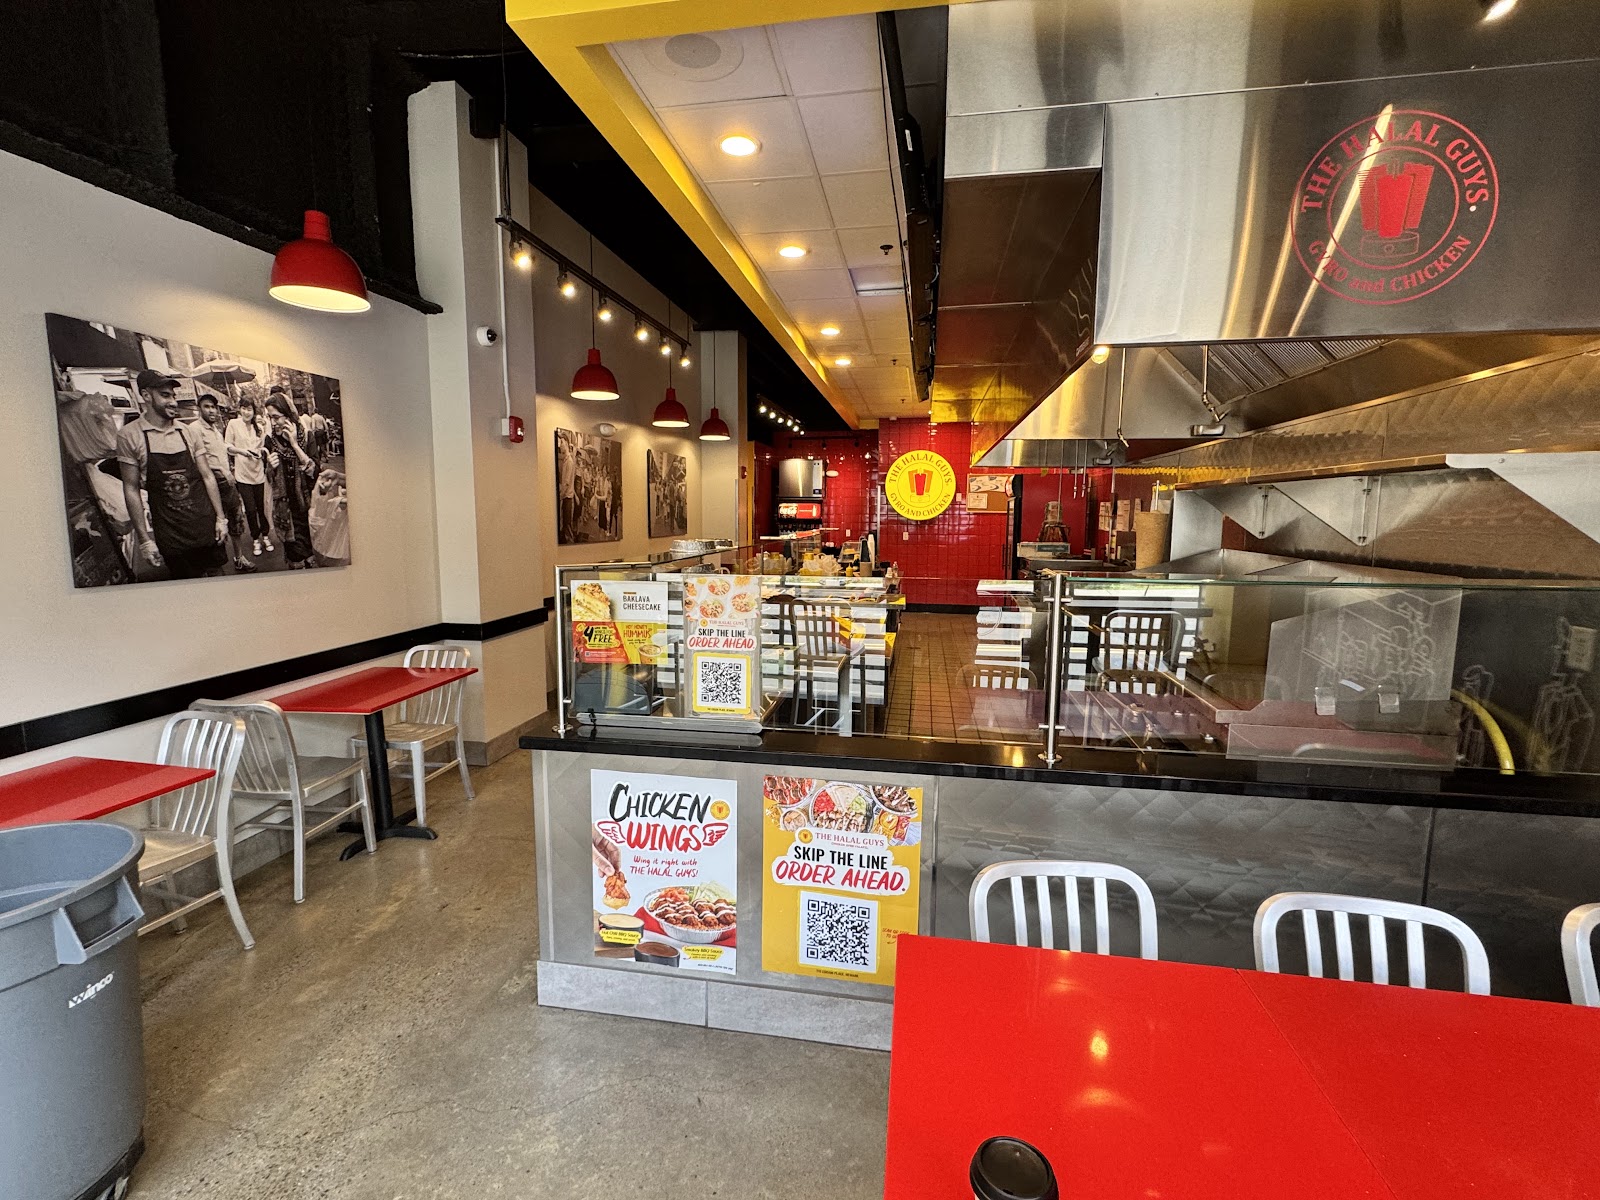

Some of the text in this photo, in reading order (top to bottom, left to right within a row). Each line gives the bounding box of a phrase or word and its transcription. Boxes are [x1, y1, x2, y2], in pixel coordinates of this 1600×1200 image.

[1301, 120, 1489, 213] THE HALAL GUYS
[1308, 234, 1472, 294] GYRO and CHICKEN
[889, 463, 903, 483] THE
[901, 453, 935, 463] HALAL
[890, 492, 905, 511] GYRO
[905, 508, 922, 517] AND
[922, 493, 951, 517] CHICKEN
[622, 595, 650, 603] BAKLAVA
[623, 602, 661, 611] CHEESECAKE
[583, 626, 594, 643] 4
[593, 634, 612, 643] FREE
[624, 628, 651, 638] HUMMUS
[698, 628, 746, 638] SKIP THE LINE
[688, 636, 755, 649] ORDER AHEAD.
[608, 783, 711, 823] CHICKEN
[626, 821, 702, 853] WINGS
[815, 832, 885, 847] THE HALAL GUYS
[633, 855, 650, 867] Wing
[661, 858, 679, 870] right
[682, 858, 698, 866] with
[794, 845, 888, 870] SKIP THE LINE
[630, 865, 698, 878] THE HALAL GUYS!
[775, 860, 906, 892] ORDER AHEAD.
